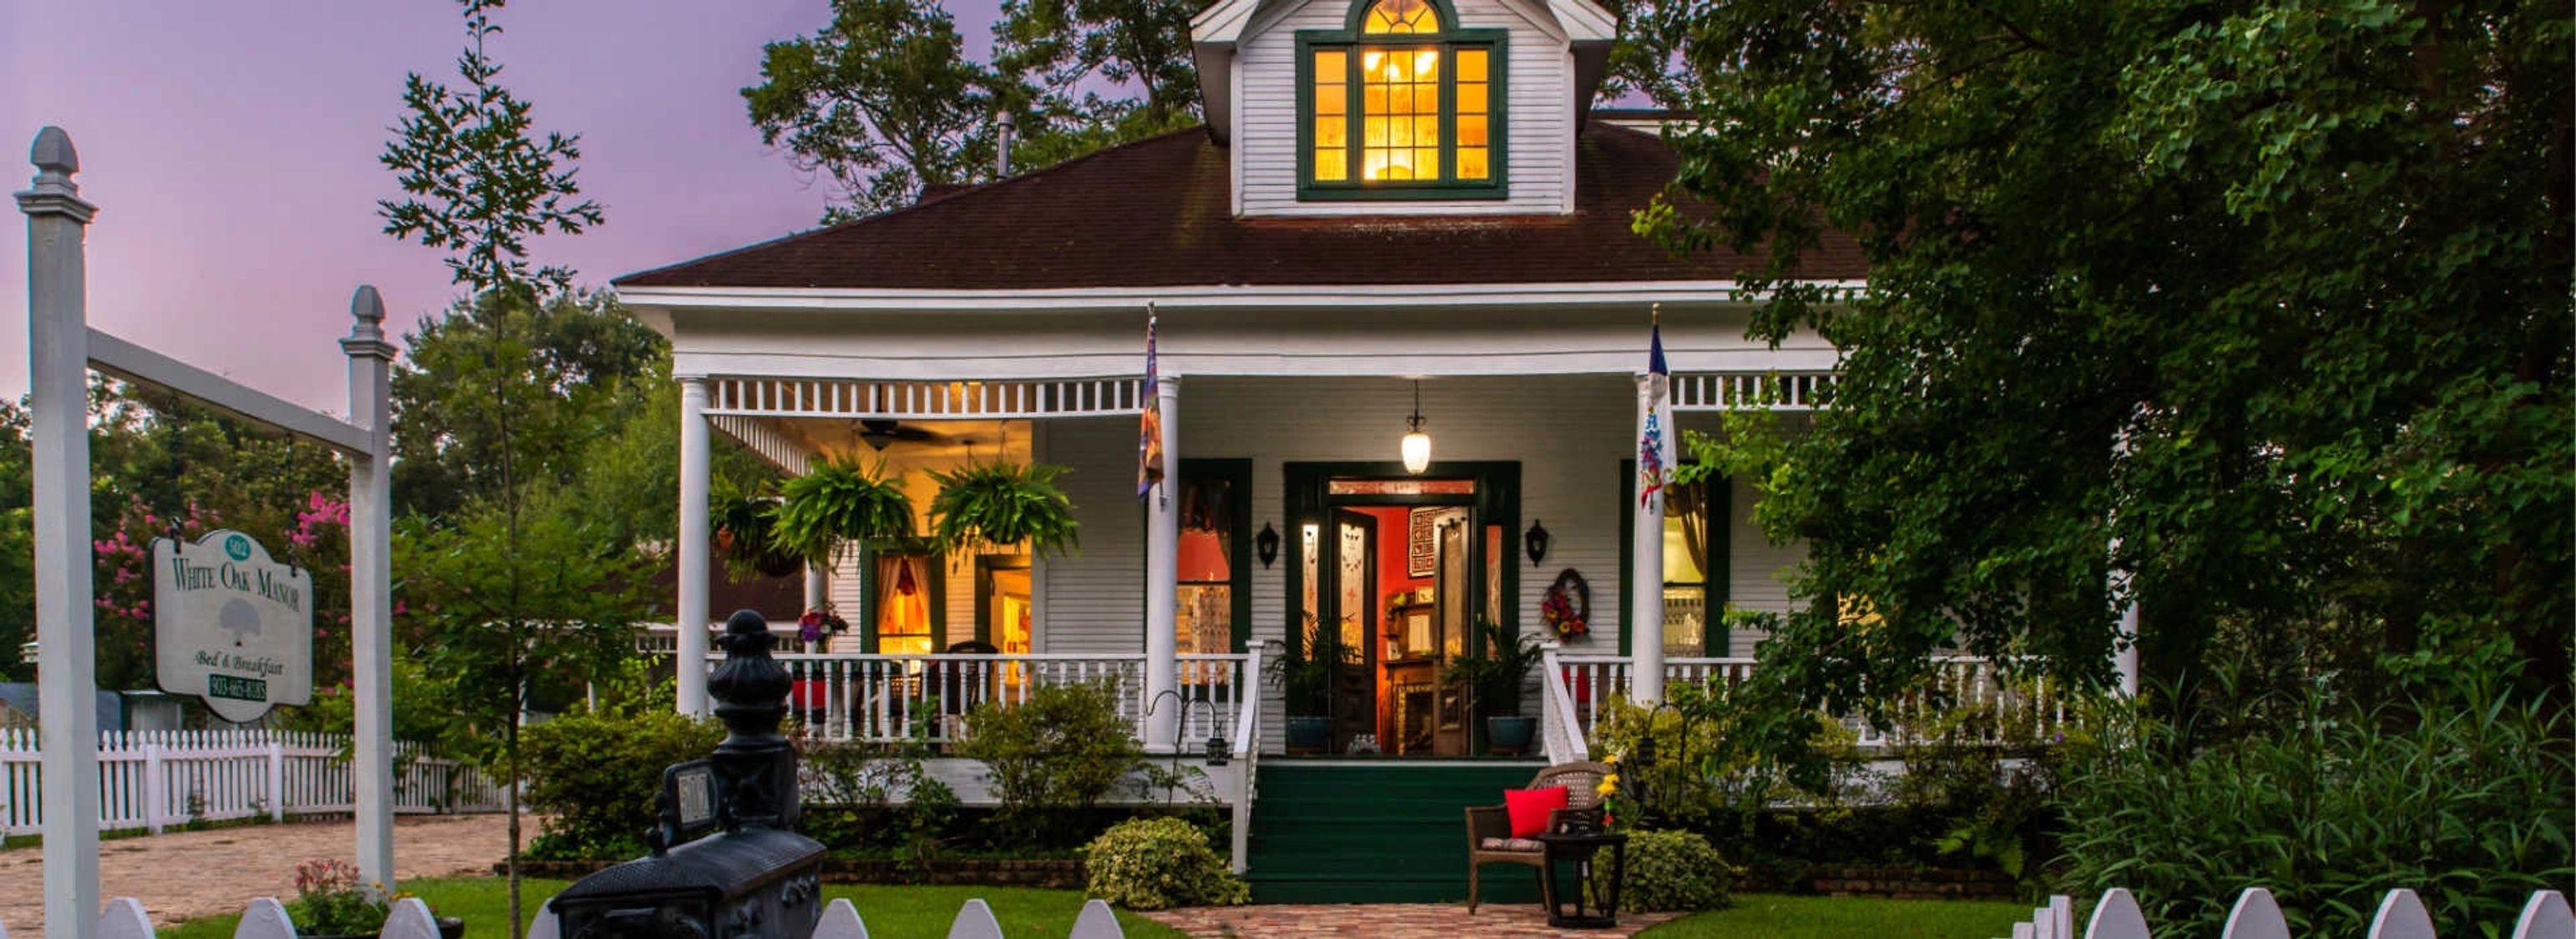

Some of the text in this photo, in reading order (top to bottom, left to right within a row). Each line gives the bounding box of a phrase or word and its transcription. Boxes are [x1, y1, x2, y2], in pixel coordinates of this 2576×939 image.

[195, 650, 283, 677] Bed & Breakfast
